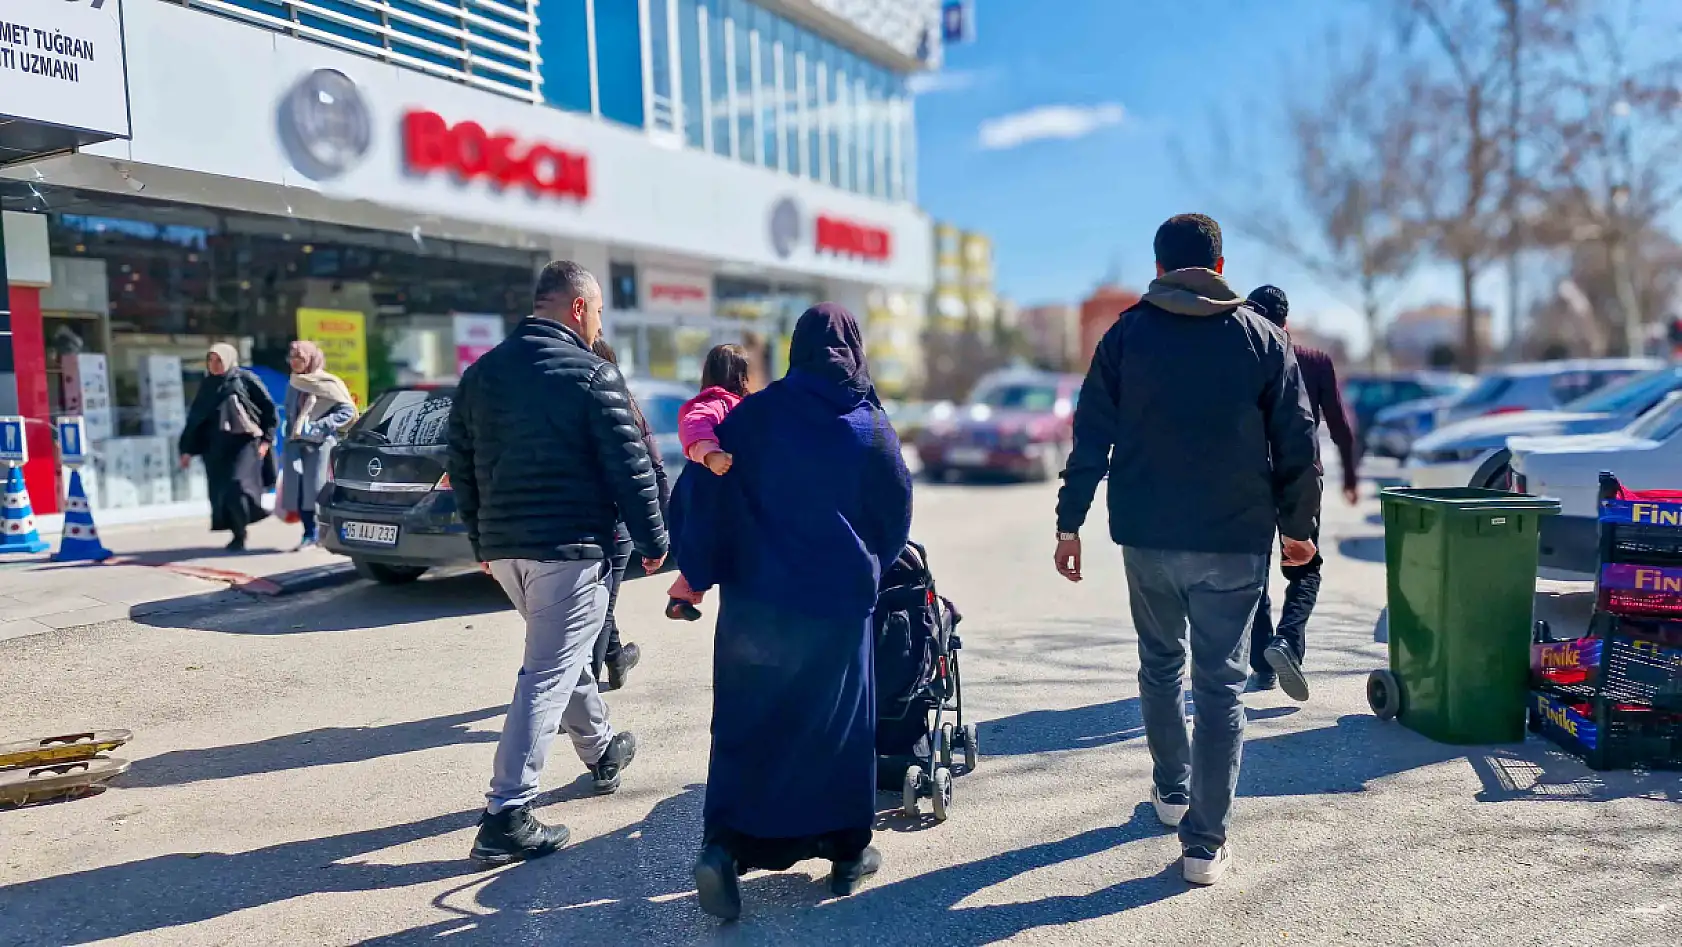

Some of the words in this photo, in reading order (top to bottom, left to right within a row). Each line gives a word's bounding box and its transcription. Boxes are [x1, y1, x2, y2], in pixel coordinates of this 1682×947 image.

[33, 28, 94, 61] TUĞRAN
[0, 44, 15, 69] Tİ
[20, 51, 79, 82] UZMANI
